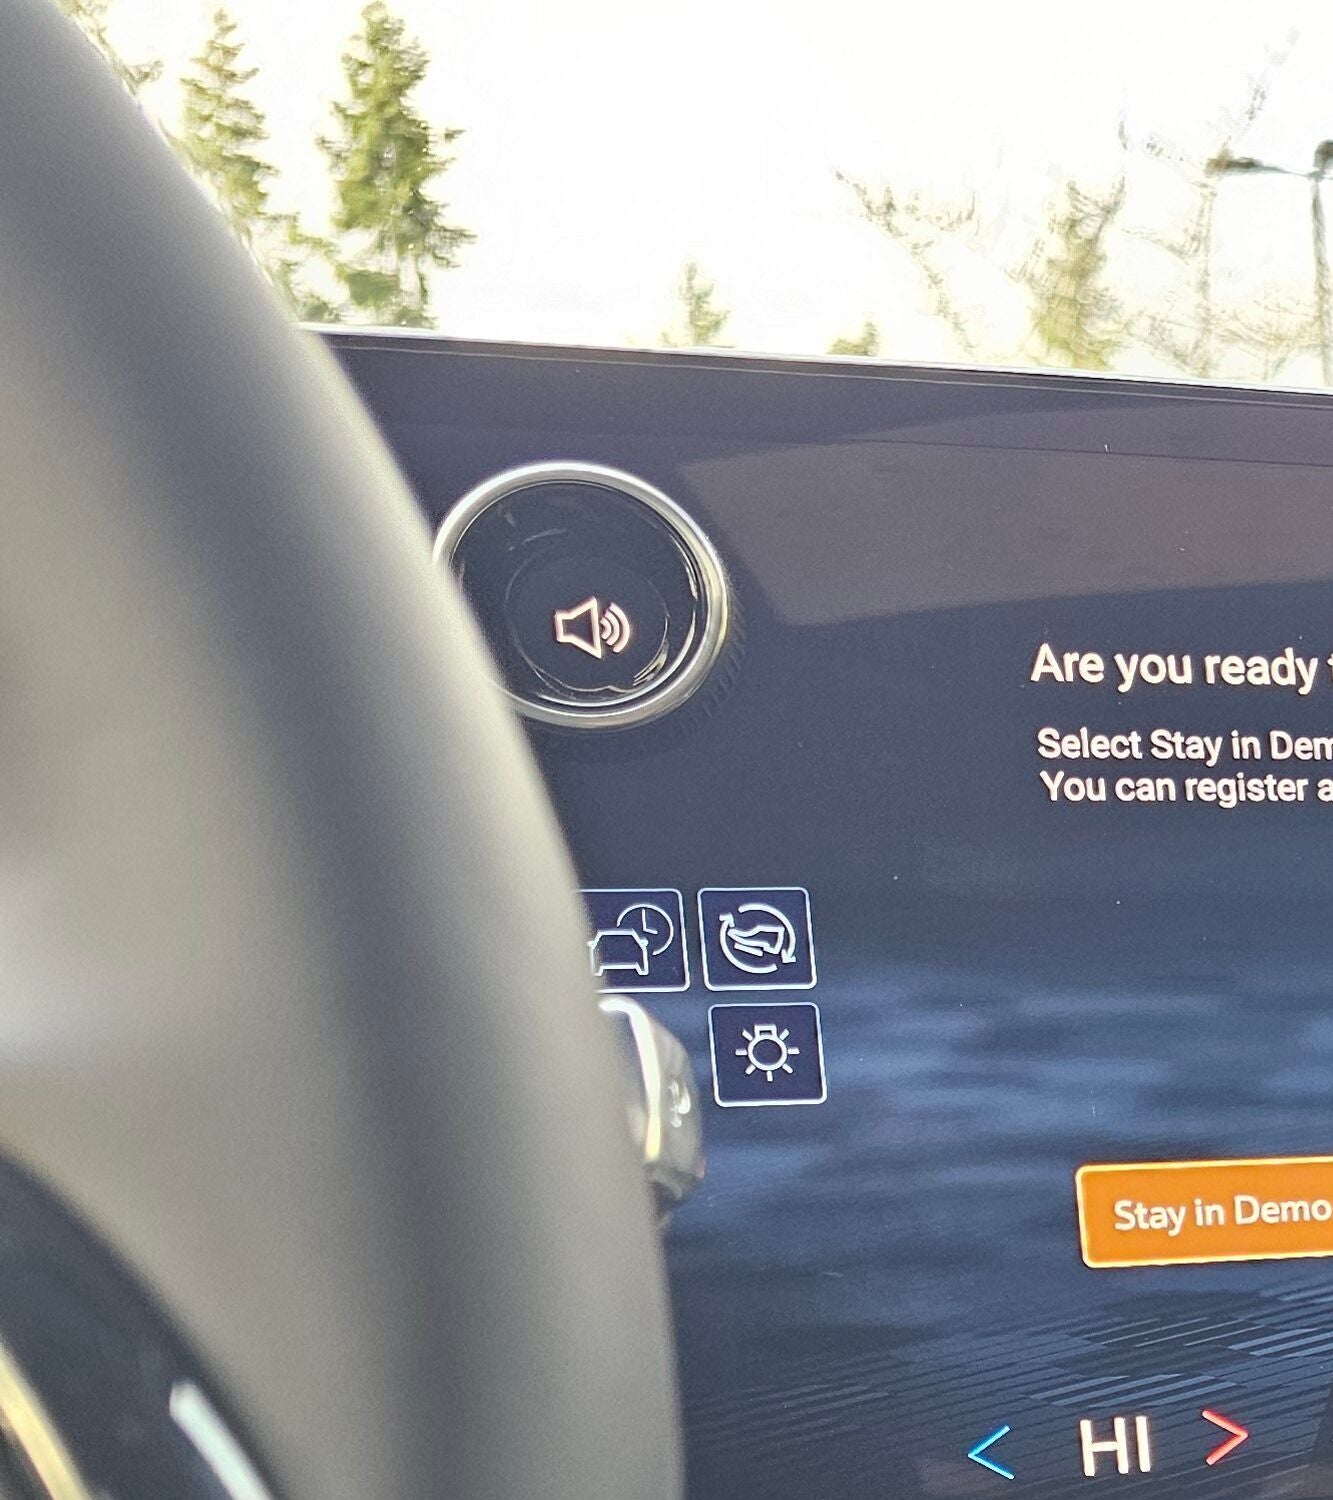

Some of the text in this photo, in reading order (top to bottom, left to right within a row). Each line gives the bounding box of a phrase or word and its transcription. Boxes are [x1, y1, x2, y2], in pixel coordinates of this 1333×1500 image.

[1030, 642, 1105, 683] Are
[1113, 653, 1194, 692] you
[1204, 646, 1319, 695] ready
[1037, 726, 1143, 760] Select
[1150, 728, 1223, 767] Stay
[1230, 729, 1262, 760] in
[1039, 770, 1107, 802] You
[1114, 777, 1177, 802] can
[1184, 773, 1309, 808] register
[1114, 1199, 1187, 1237] Stay
[1193, 1198, 1226, 1226] in
[1234, 1194, 1333, 1225] Demo
[1079, 1415, 1152, 1477] HI
